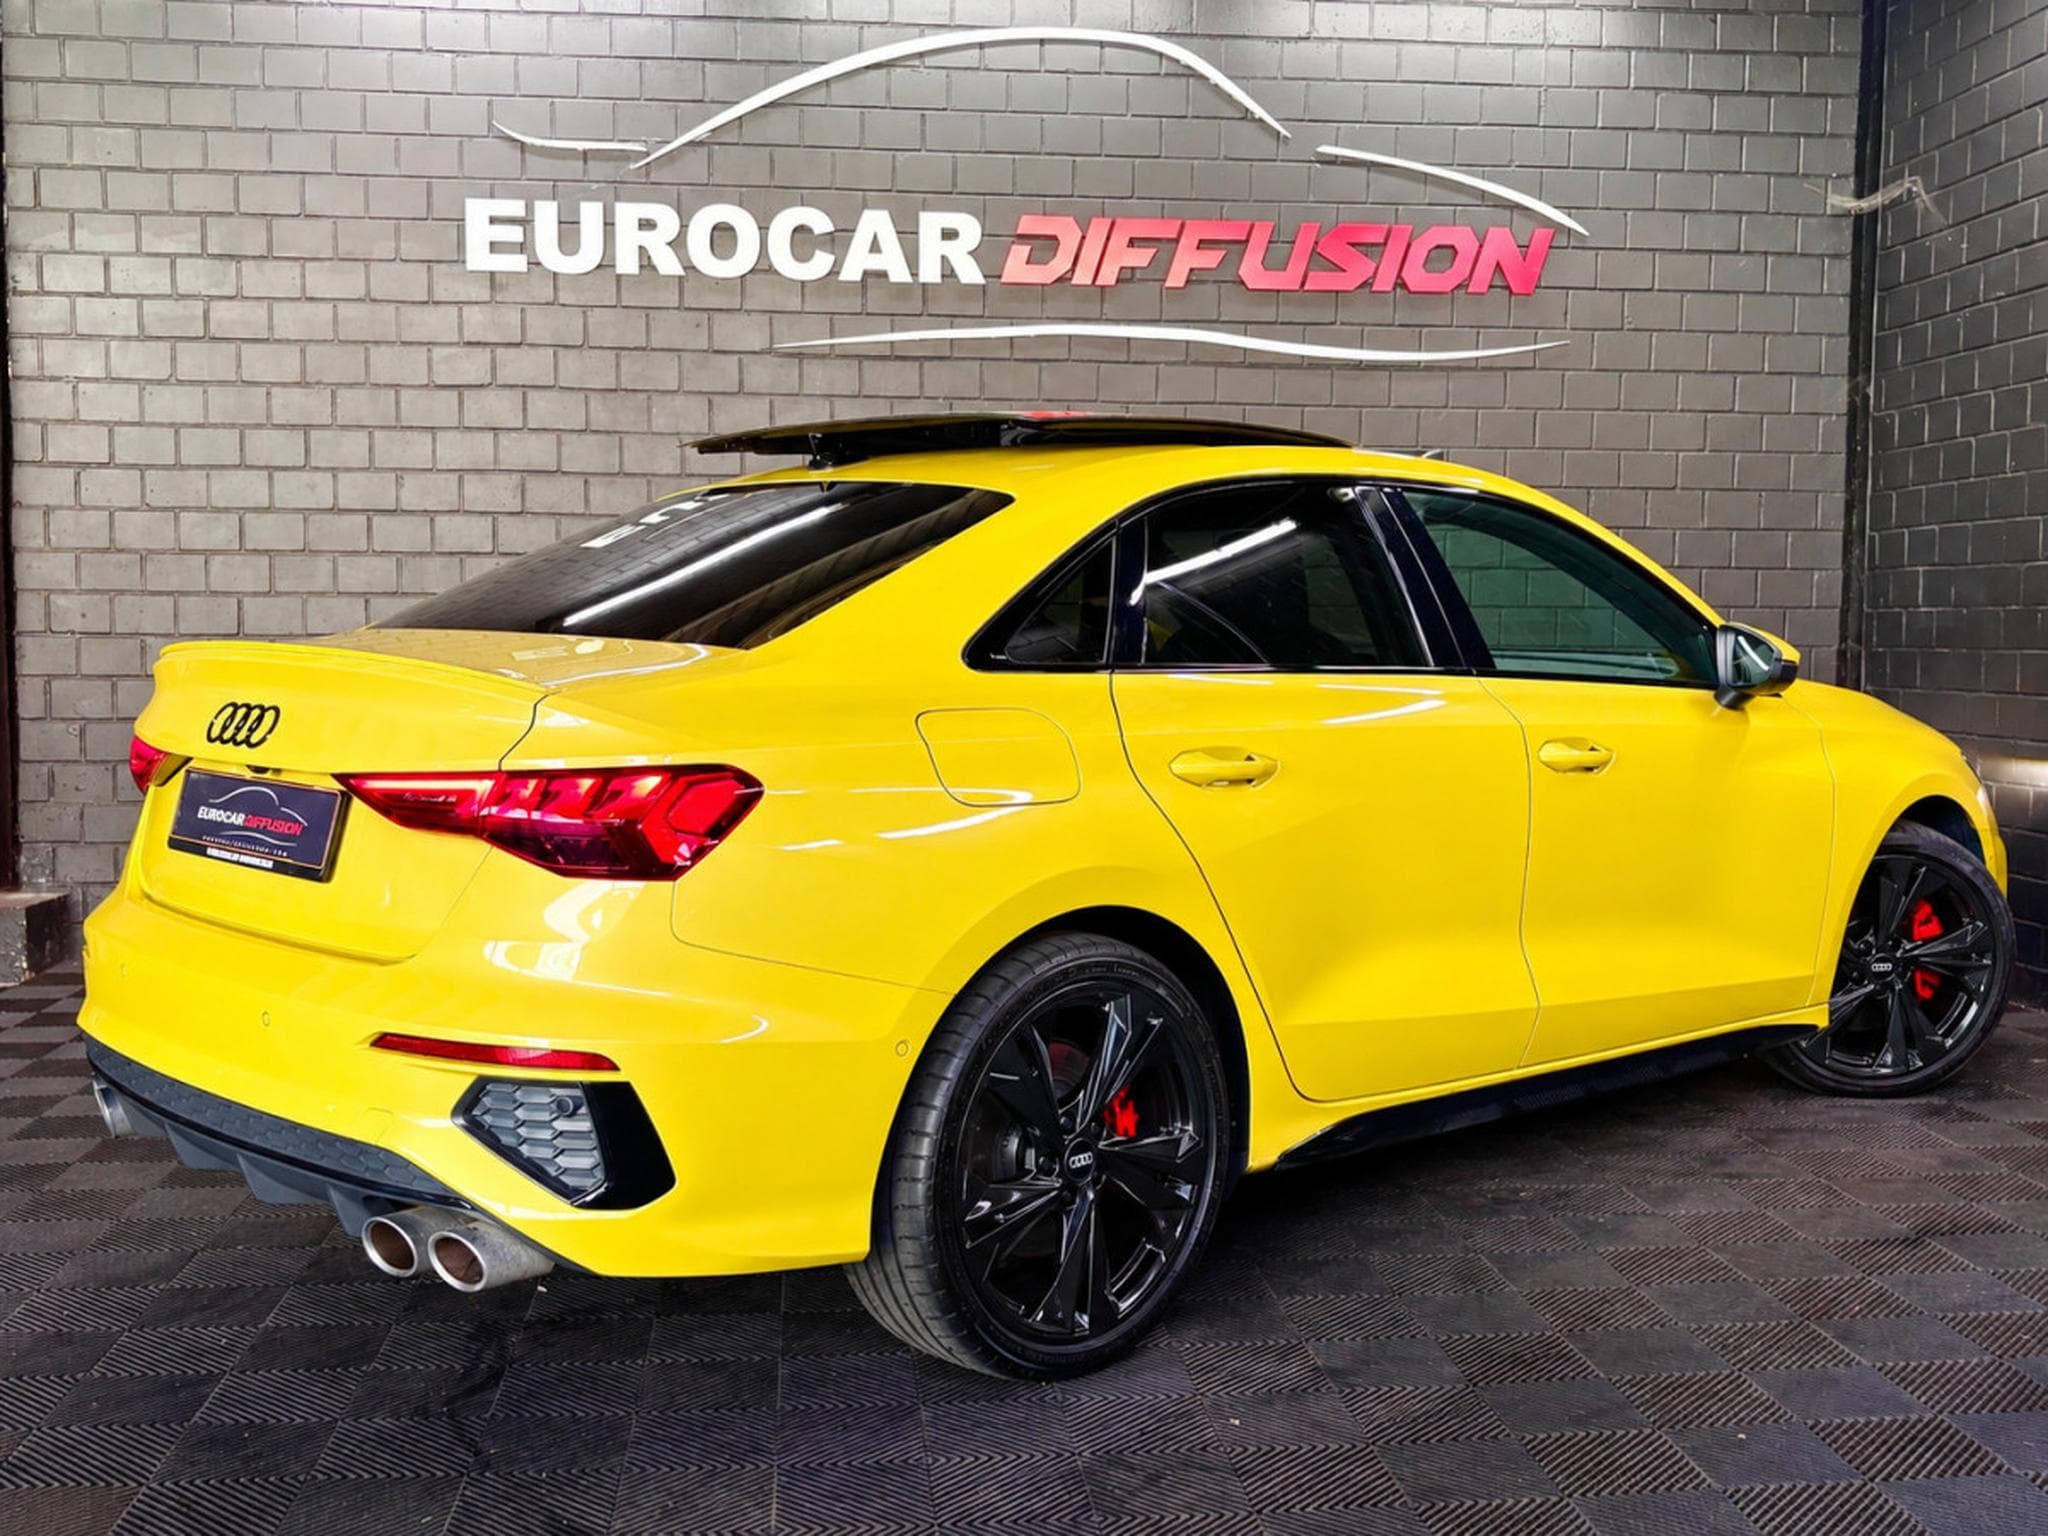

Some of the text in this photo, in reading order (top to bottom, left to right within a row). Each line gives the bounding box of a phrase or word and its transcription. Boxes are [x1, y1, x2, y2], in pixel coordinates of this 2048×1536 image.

[464, 197, 1556, 296] EUROCAR DIFFUSION
[198, 806, 303, 835] EUROCAR DIFFUSION
